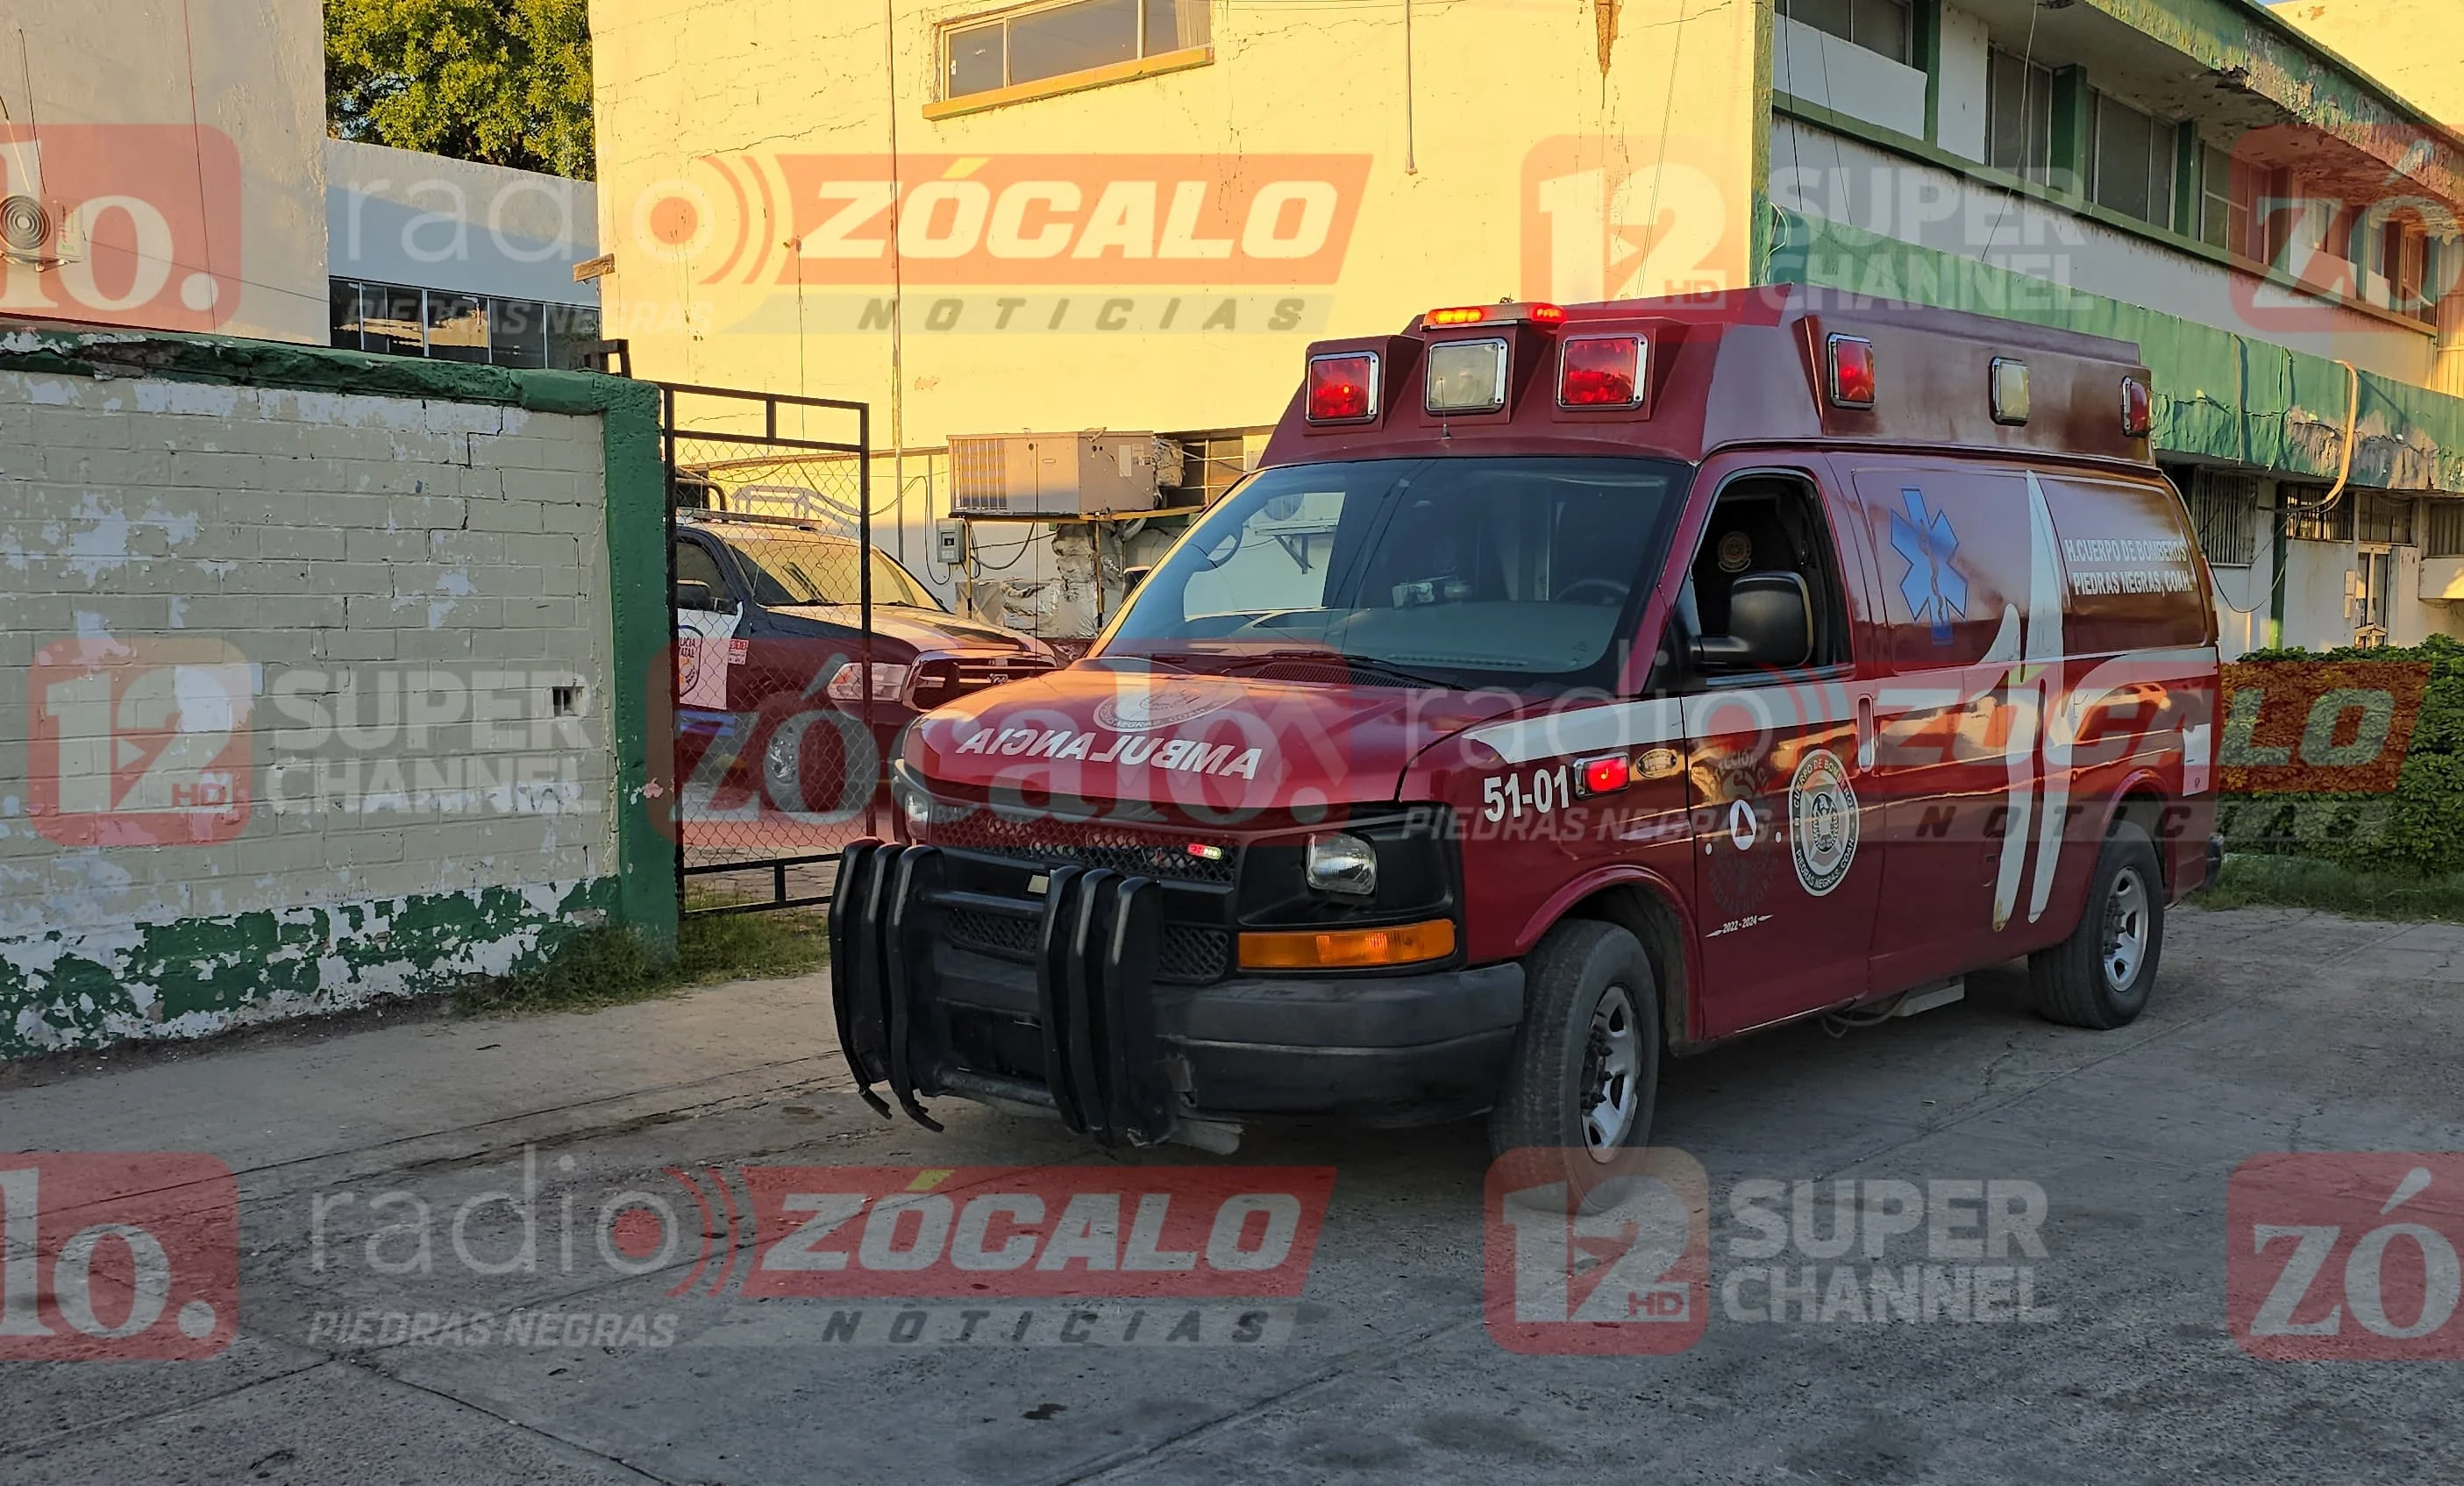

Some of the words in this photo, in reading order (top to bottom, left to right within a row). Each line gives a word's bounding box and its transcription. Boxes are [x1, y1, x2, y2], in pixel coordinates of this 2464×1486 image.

[2121, 538, 2137, 562] DE
[2137, 538, 2188, 562] BOMBEROS
[2073, 571, 2120, 595] PIEDRAS
[1813, 758, 1824, 770] DE
[1484, 764, 1570, 822] 51-01
